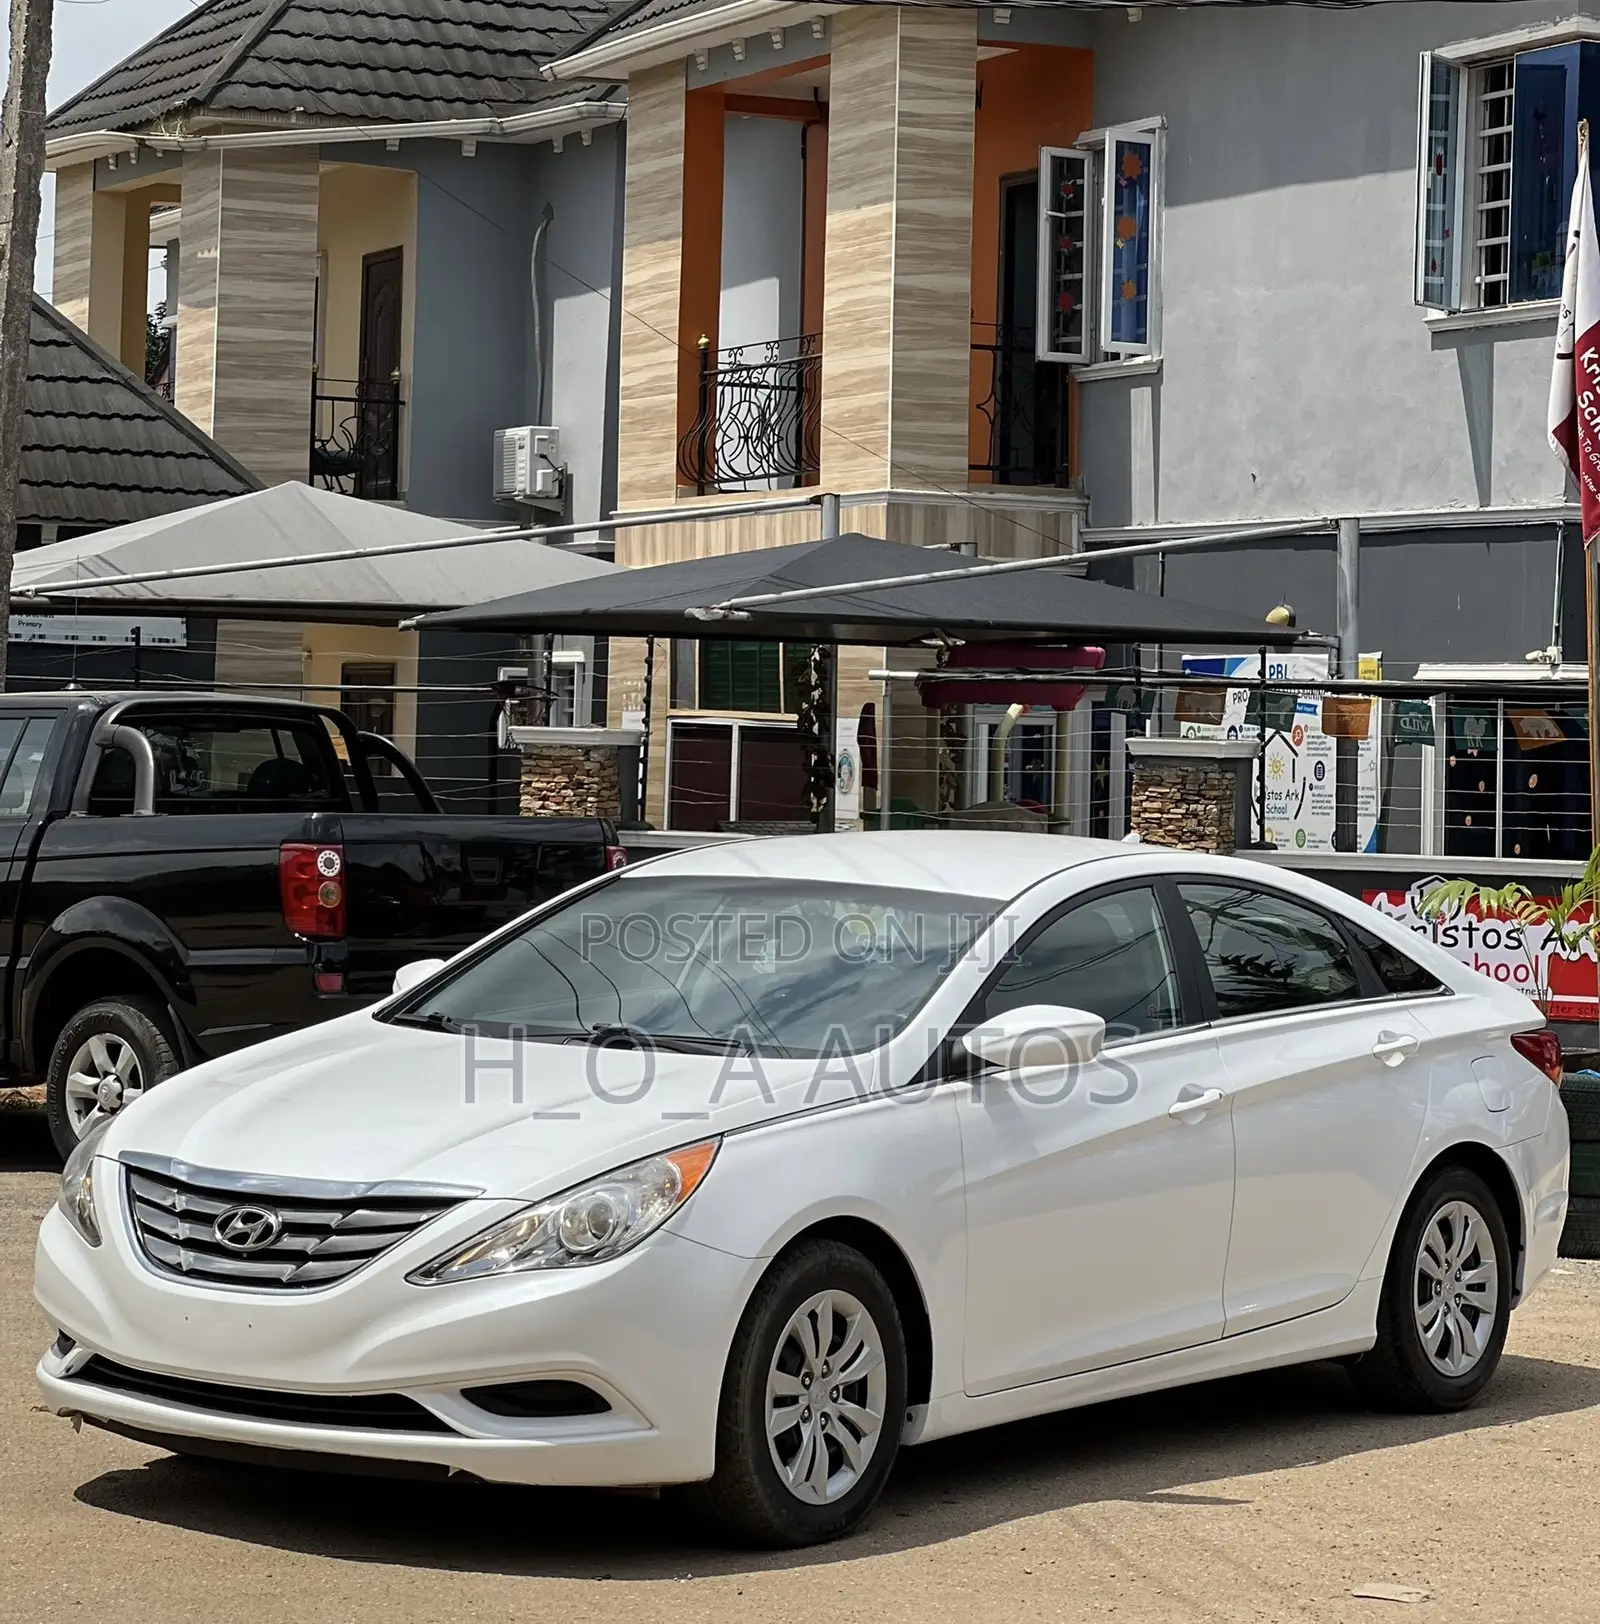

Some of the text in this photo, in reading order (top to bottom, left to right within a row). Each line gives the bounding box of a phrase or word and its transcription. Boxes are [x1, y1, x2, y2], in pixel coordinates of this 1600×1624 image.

[17, 620, 43, 629] Primary
[1232, 689, 1249, 705] PRO
[1266, 788, 1300, 801] stos Ark
[1265, 803, 1288, 815] School
